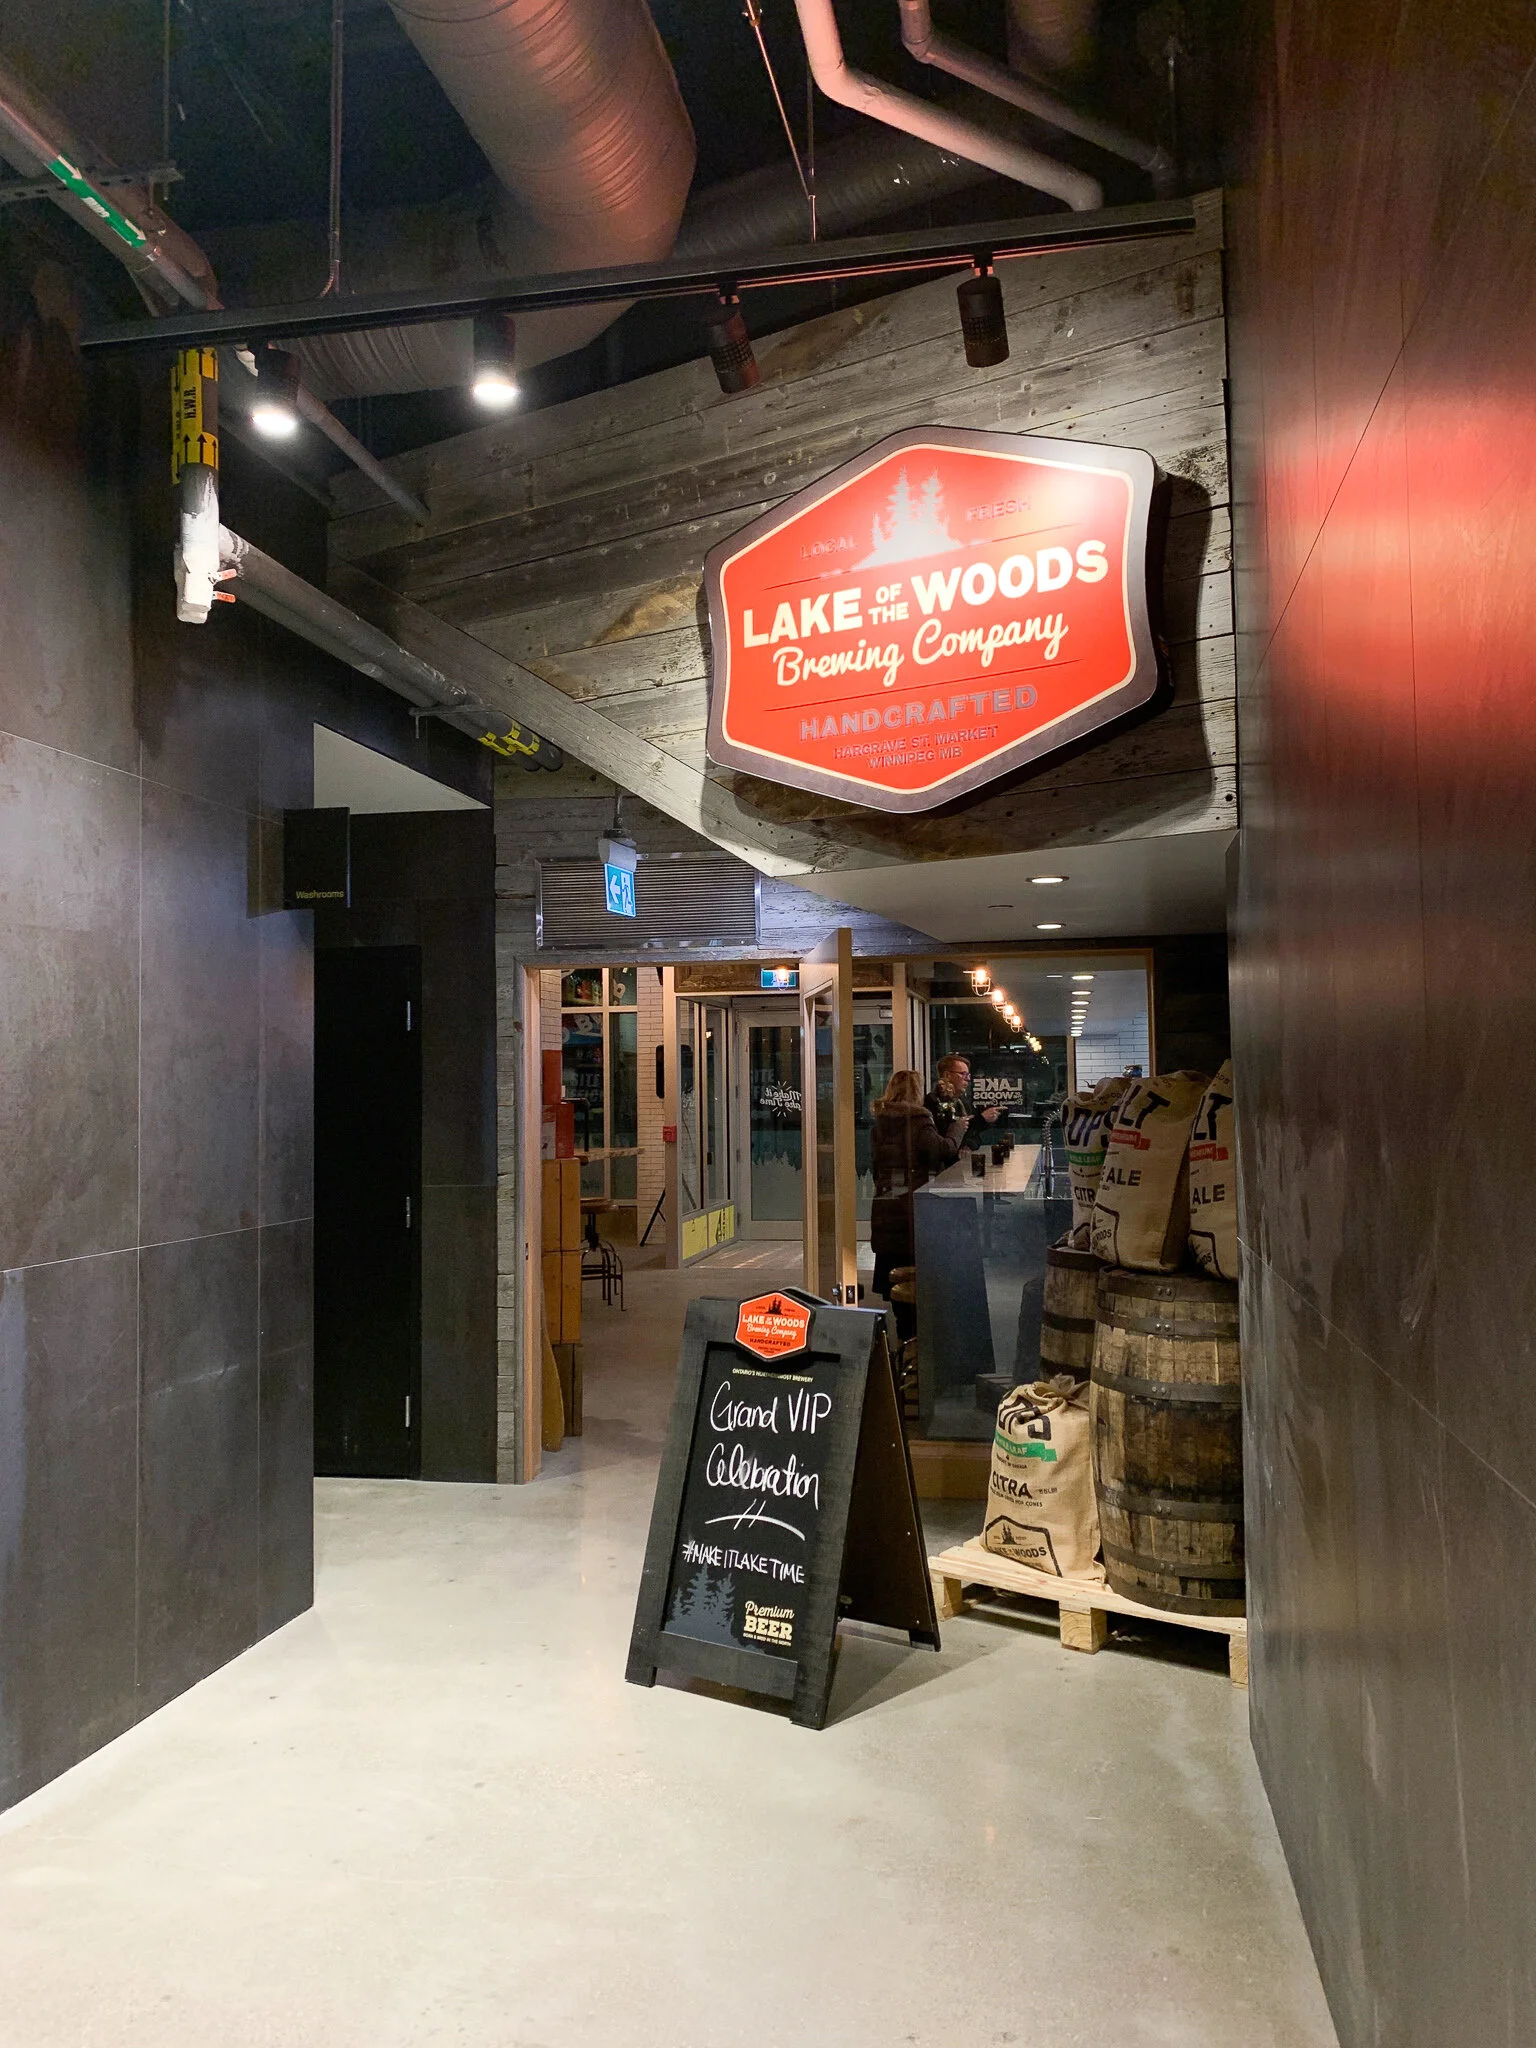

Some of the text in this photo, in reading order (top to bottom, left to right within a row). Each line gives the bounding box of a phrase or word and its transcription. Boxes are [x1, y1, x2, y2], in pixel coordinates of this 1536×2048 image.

[965, 495, 1031, 523] FRESH
[800, 536, 858, 561] LOCAL
[911, 540, 1108, 613] WOODS
[875, 583, 902, 603] OF
[743, 587, 863, 648] LAKE
[868, 602, 909, 625] THE
[773, 612, 1069, 687] Brewing Company
[800, 685, 1037, 741] HANDCRAFTED
[833, 724, 998, 760] HARGRAVE ST. MARKET
[867, 745, 962, 770] WINNIPEG MB
[296, 890, 344, 899] Washrooms
[1105, 1167, 1142, 1187] ALE
[1074, 1186, 1097, 1203] CITR
[1191, 1184, 1225, 1206] ALE
[742, 1313, 765, 1325] LAKE
[773, 1317, 805, 1328] WOODS
[749, 1338, 792, 1347] HANDCRAFTED
[792, 1374, 814, 1383] BREWERY
[710, 1381, 832, 1434] Grand VIP
[706, 1442, 819, 1510] Celebration
[993, 1471, 1032, 1499] CITRA
[1015, 1547, 1047, 1558] WOODS
[745, 1600, 795, 1619] Premium
[743, 1615, 793, 1640] BEER
